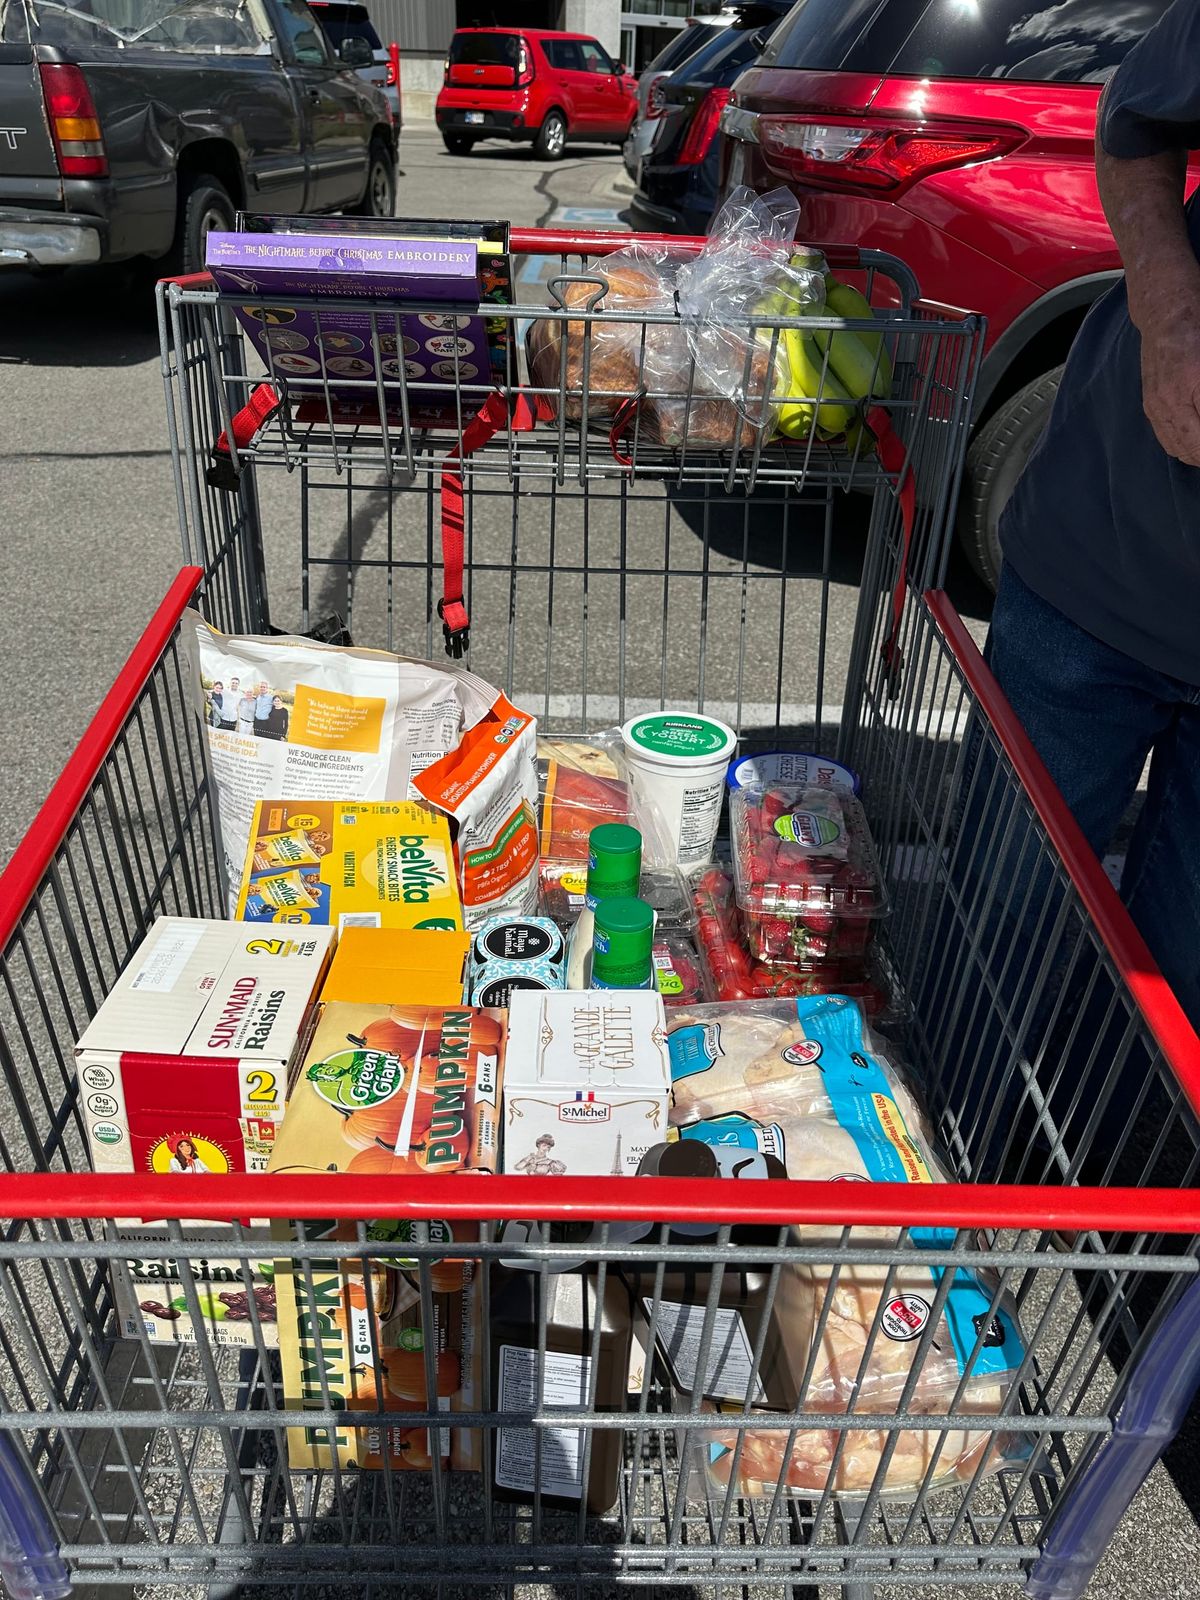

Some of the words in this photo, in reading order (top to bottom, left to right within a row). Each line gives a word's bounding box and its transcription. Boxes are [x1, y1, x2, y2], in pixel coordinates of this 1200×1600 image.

[258, 243, 308, 258] NIGHTMARE
[309, 246, 336, 258] BEFORE
[337, 247, 383, 262] CHRISTMAS
[387, 250, 473, 263] EMBROIDERY
[310, 289, 389, 297] EMBROIDERY
[661, 729, 698, 738] GREEK
[665, 722, 704, 730] KIRKLAND
[235, 738, 260, 749] FAMILY
[651, 731, 706, 745] YOGURT
[241, 748, 258, 758] IDEA
[288, 748, 300, 757] WE
[300, 750, 328, 762] SOURCE
[328, 754, 352, 763] CLEAN
[287, 757, 319, 768] ORGANIC
[319, 761, 364, 772] INGREDIENTS
[780, 755, 794, 779] CHEESE
[794, 756, 808, 782] COTTAGE
[448, 784, 468, 804] ROASTED
[467, 768, 483, 788] PEANUT
[481, 752, 498, 770] POWDER
[441, 781, 462, 800] ORGANIC
[300, 818, 313, 826] 15
[386, 836, 397, 859] ENERGY
[343, 851, 355, 870] VARIETY
[377, 859, 385, 873] QUALITY
[470, 855, 483, 865] HOW
[483, 852, 493, 860] TO
[387, 859, 399, 882] SNACK
[399, 835, 446, 903] belVita
[343, 870, 355, 887] PACK
[378, 873, 386, 900] INGREDIENTS
[388, 883, 400, 902] BITES
[474, 886, 501, 902] COMBINE
[287, 913, 303, 924] 10
[246, 939, 285, 955] 2
[304, 940, 318, 953] LBS.
[513, 929, 528, 953] maya
[199, 977, 209, 989] OPEN
[206, 977, 216, 990] HERE
[244, 990, 286, 1050] Raisins
[234, 1019, 251, 1049] CALIFORNIA
[573, 1006, 602, 1057] GRANDE
[599, 1005, 634, 1070] GALETTE
[579, 1058, 596, 1069] LA
[350, 1052, 381, 1101] Green
[373, 1053, 400, 1097] Giant
[483, 1062, 492, 1082] CANS
[246, 1070, 278, 1102] 2
[426, 1011, 473, 1167] PUMPKIN
[478, 1084, 494, 1094] 6
[874, 1094, 887, 1109] USA
[97, 1132, 120, 1140] ORGANIC
[250, 1162, 257, 1170] 4
[904, 1157, 921, 1181] Raised
[120, 1234, 171, 1242] ALIFORNI
[359, 1318, 367, 1337] CANS
[887, 1322, 899, 1333] COOK
[229, 1336, 248, 1344] 1.81kg
[355, 1344, 371, 1356] 6
[368, 1426, 381, 1455] 100%
[393, 1426, 401, 1456] PUMPKI
